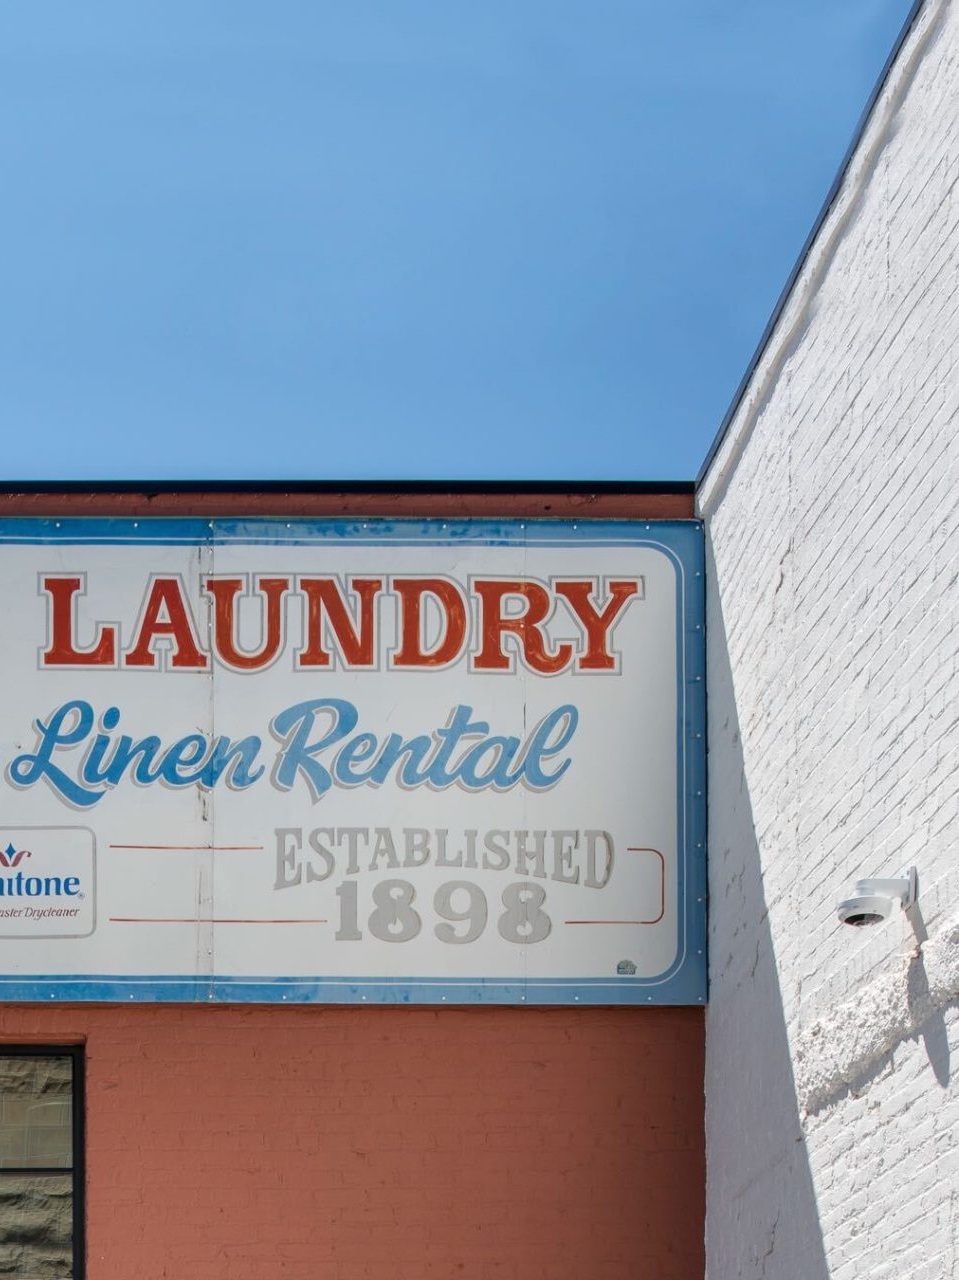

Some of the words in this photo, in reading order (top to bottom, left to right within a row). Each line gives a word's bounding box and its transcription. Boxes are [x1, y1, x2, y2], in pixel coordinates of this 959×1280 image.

[37, 571, 645, 677] LAUNDRY
[4, 700, 265, 808] Linen
[268, 698, 579, 803] Rental
[273, 826, 615, 890] ESTABLISHED
[25, 907, 80, 920] Drycleaner
[335, 879, 552, 944] 1898
